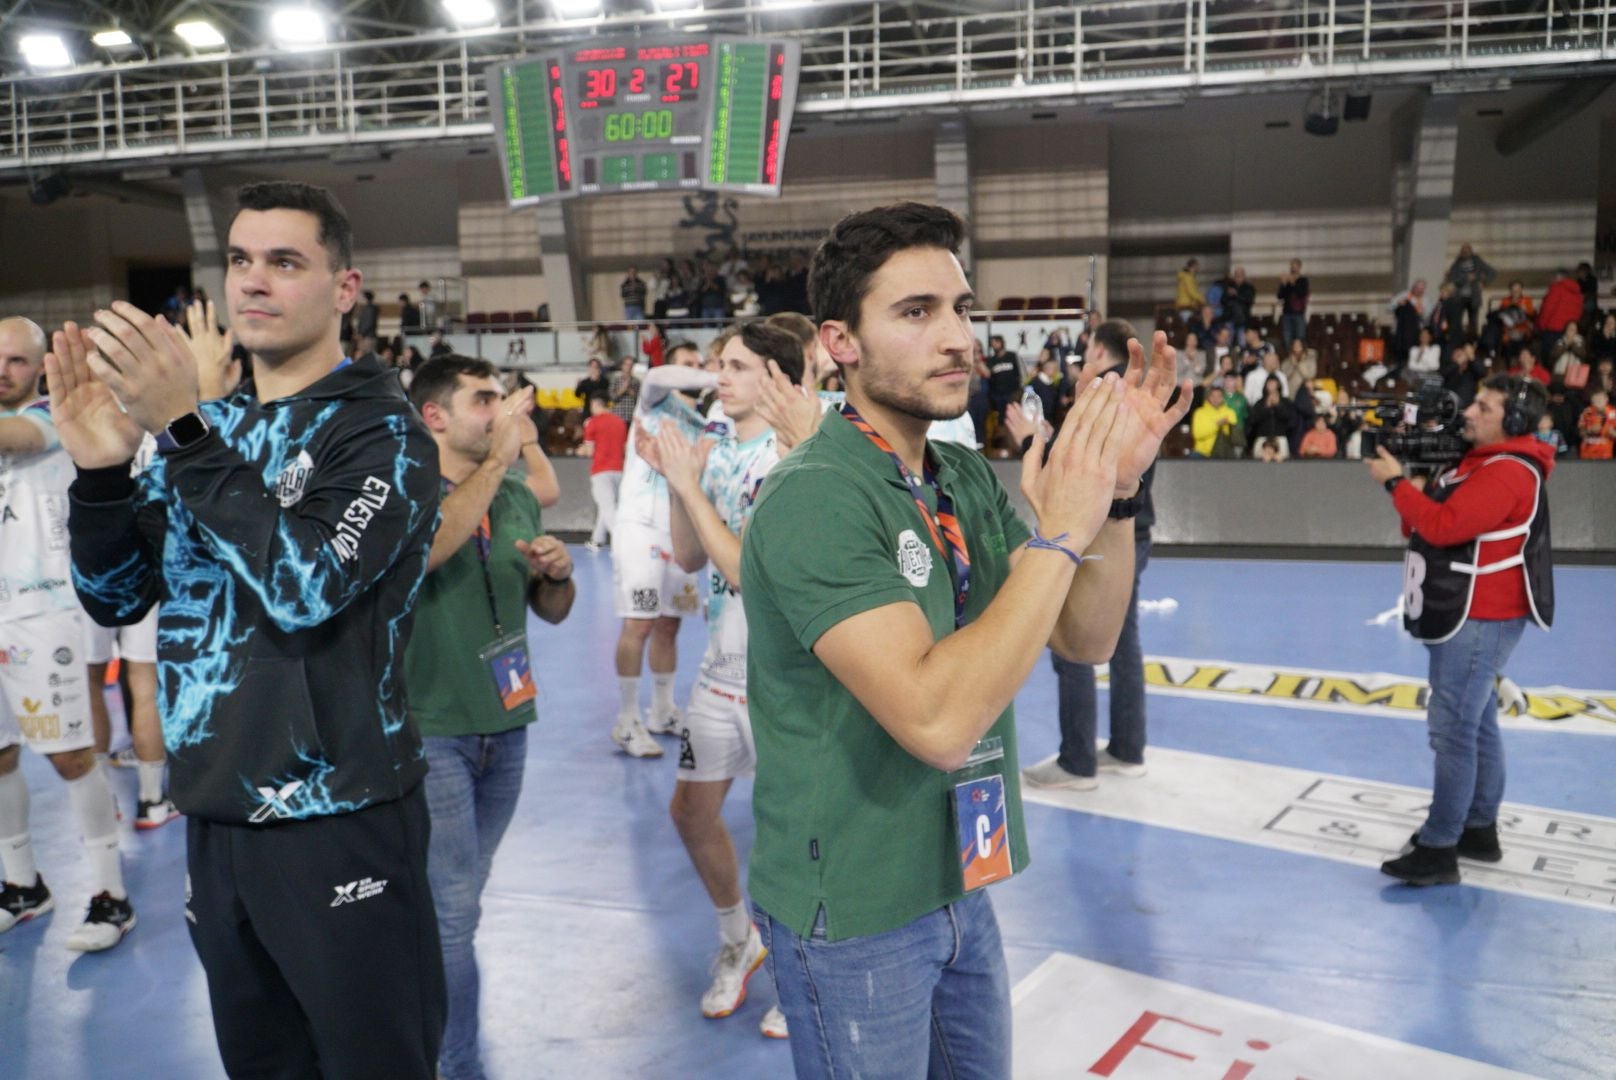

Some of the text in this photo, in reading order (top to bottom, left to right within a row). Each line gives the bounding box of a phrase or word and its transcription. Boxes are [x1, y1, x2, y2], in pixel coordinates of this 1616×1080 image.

[586, 68, 616, 99] 30
[629, 67, 645, 94] 2
[666, 61, 699, 93] 27
[604, 110, 673, 142] 60:00
[508, 668, 524, 692] A
[976, 814, 993, 859] C
